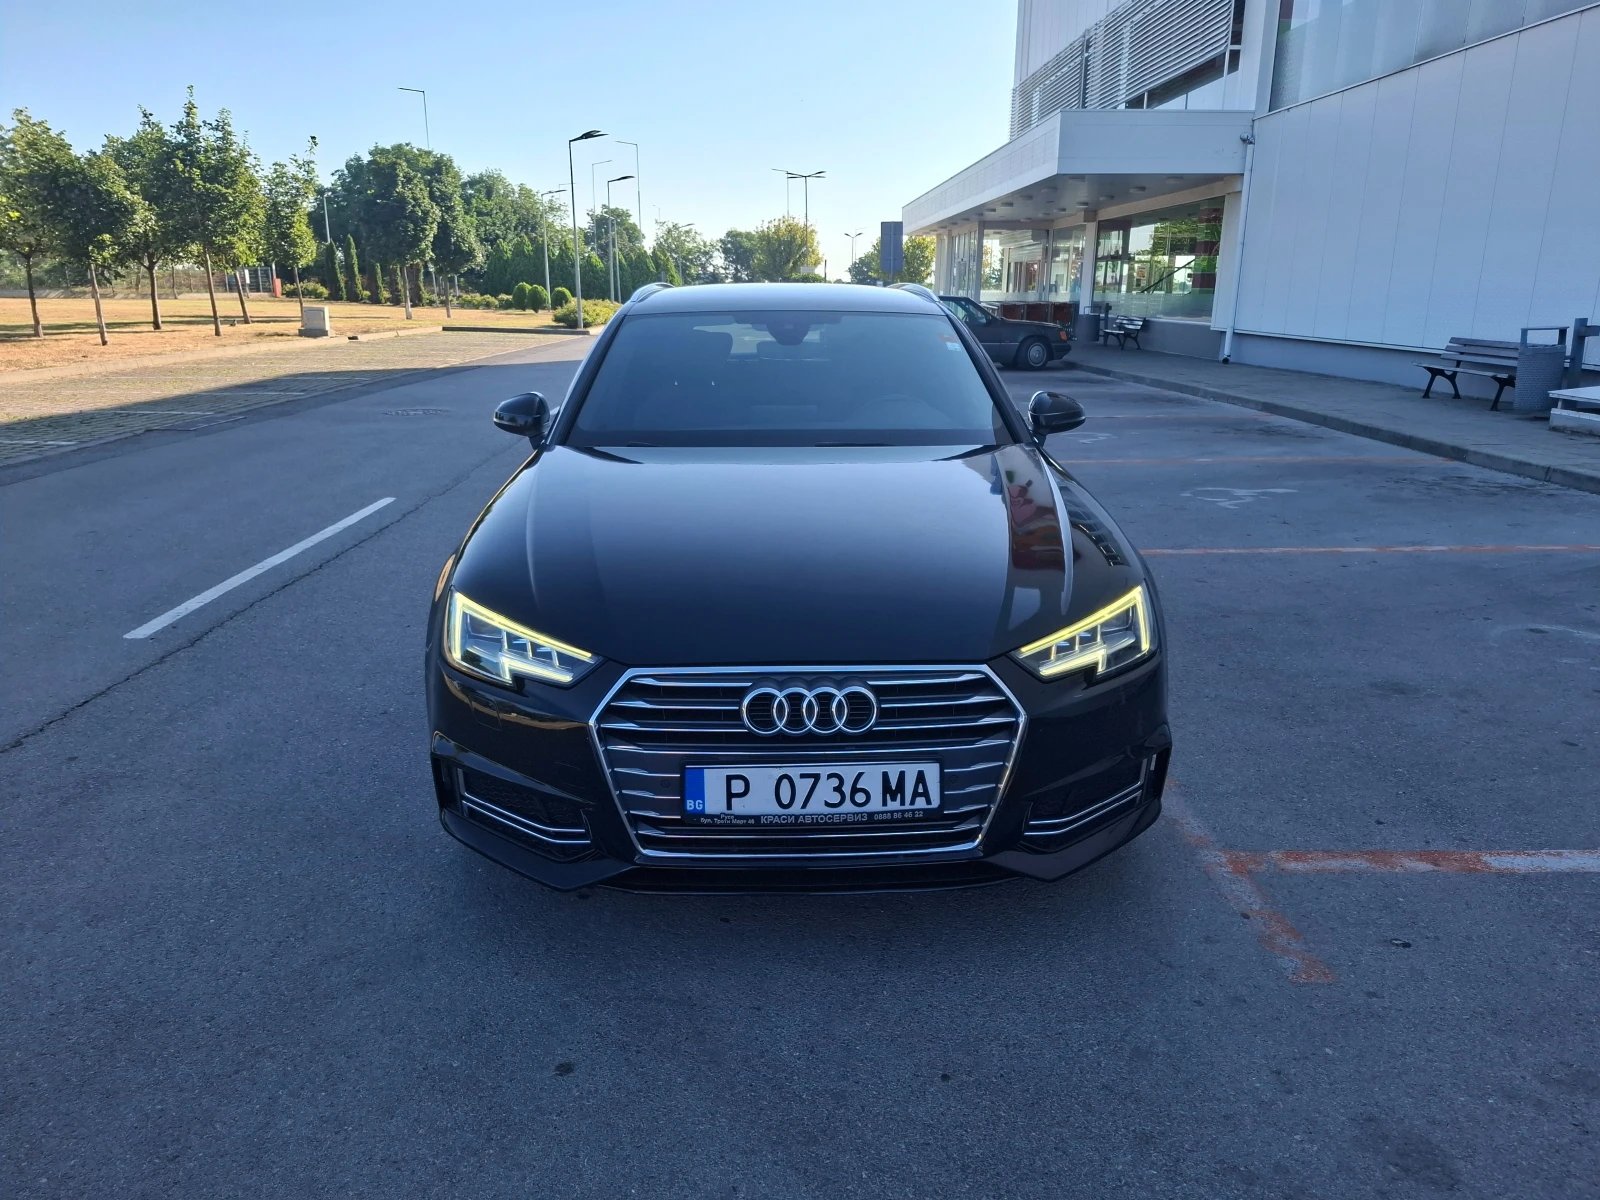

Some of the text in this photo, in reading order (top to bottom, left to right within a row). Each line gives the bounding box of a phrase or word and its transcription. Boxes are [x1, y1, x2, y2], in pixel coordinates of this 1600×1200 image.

[725, 770, 932, 810] P 0736 MA
[687, 800, 704, 811] BG
[760, 815, 796, 824] КРАСИ
[797, 813, 868, 823] АВТОСЕРВИЗ
